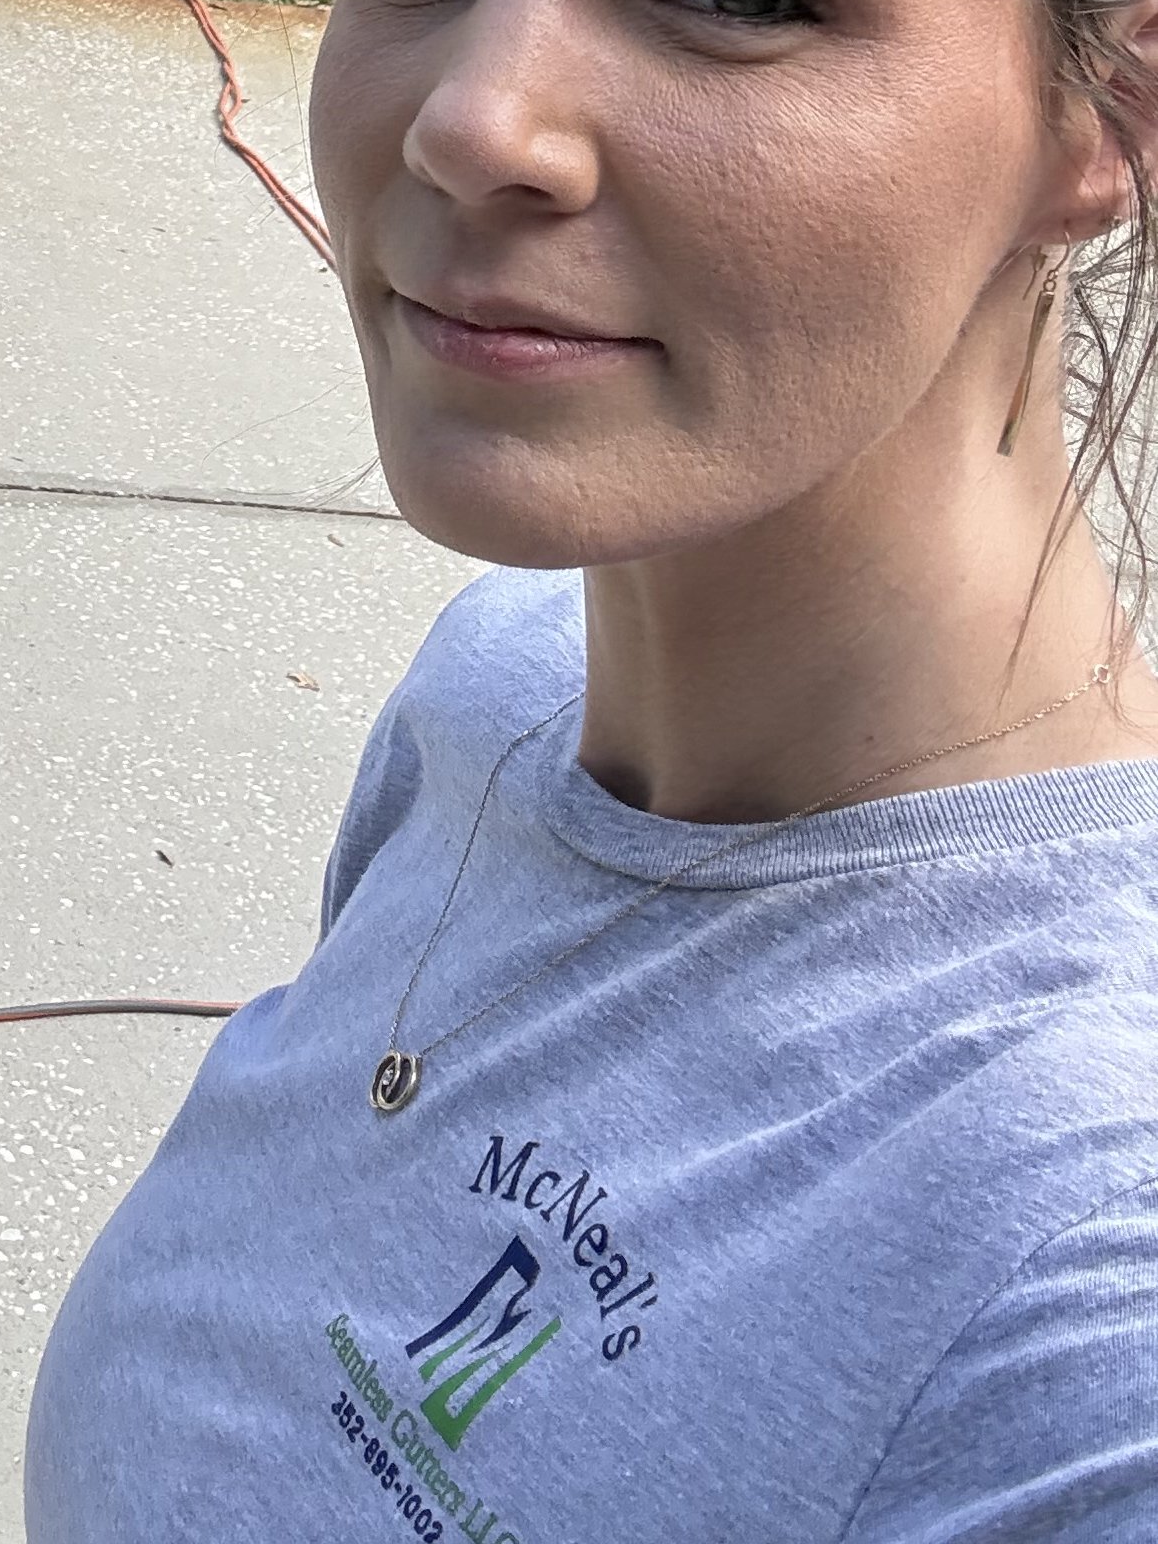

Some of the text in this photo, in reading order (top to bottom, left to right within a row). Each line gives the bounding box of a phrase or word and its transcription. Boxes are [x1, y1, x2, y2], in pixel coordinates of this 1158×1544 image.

[468, 1135, 658, 1361] McNeal's
[325, 1312, 394, 1423] Seamless
[391, 1408, 466, 1517] Gutters
